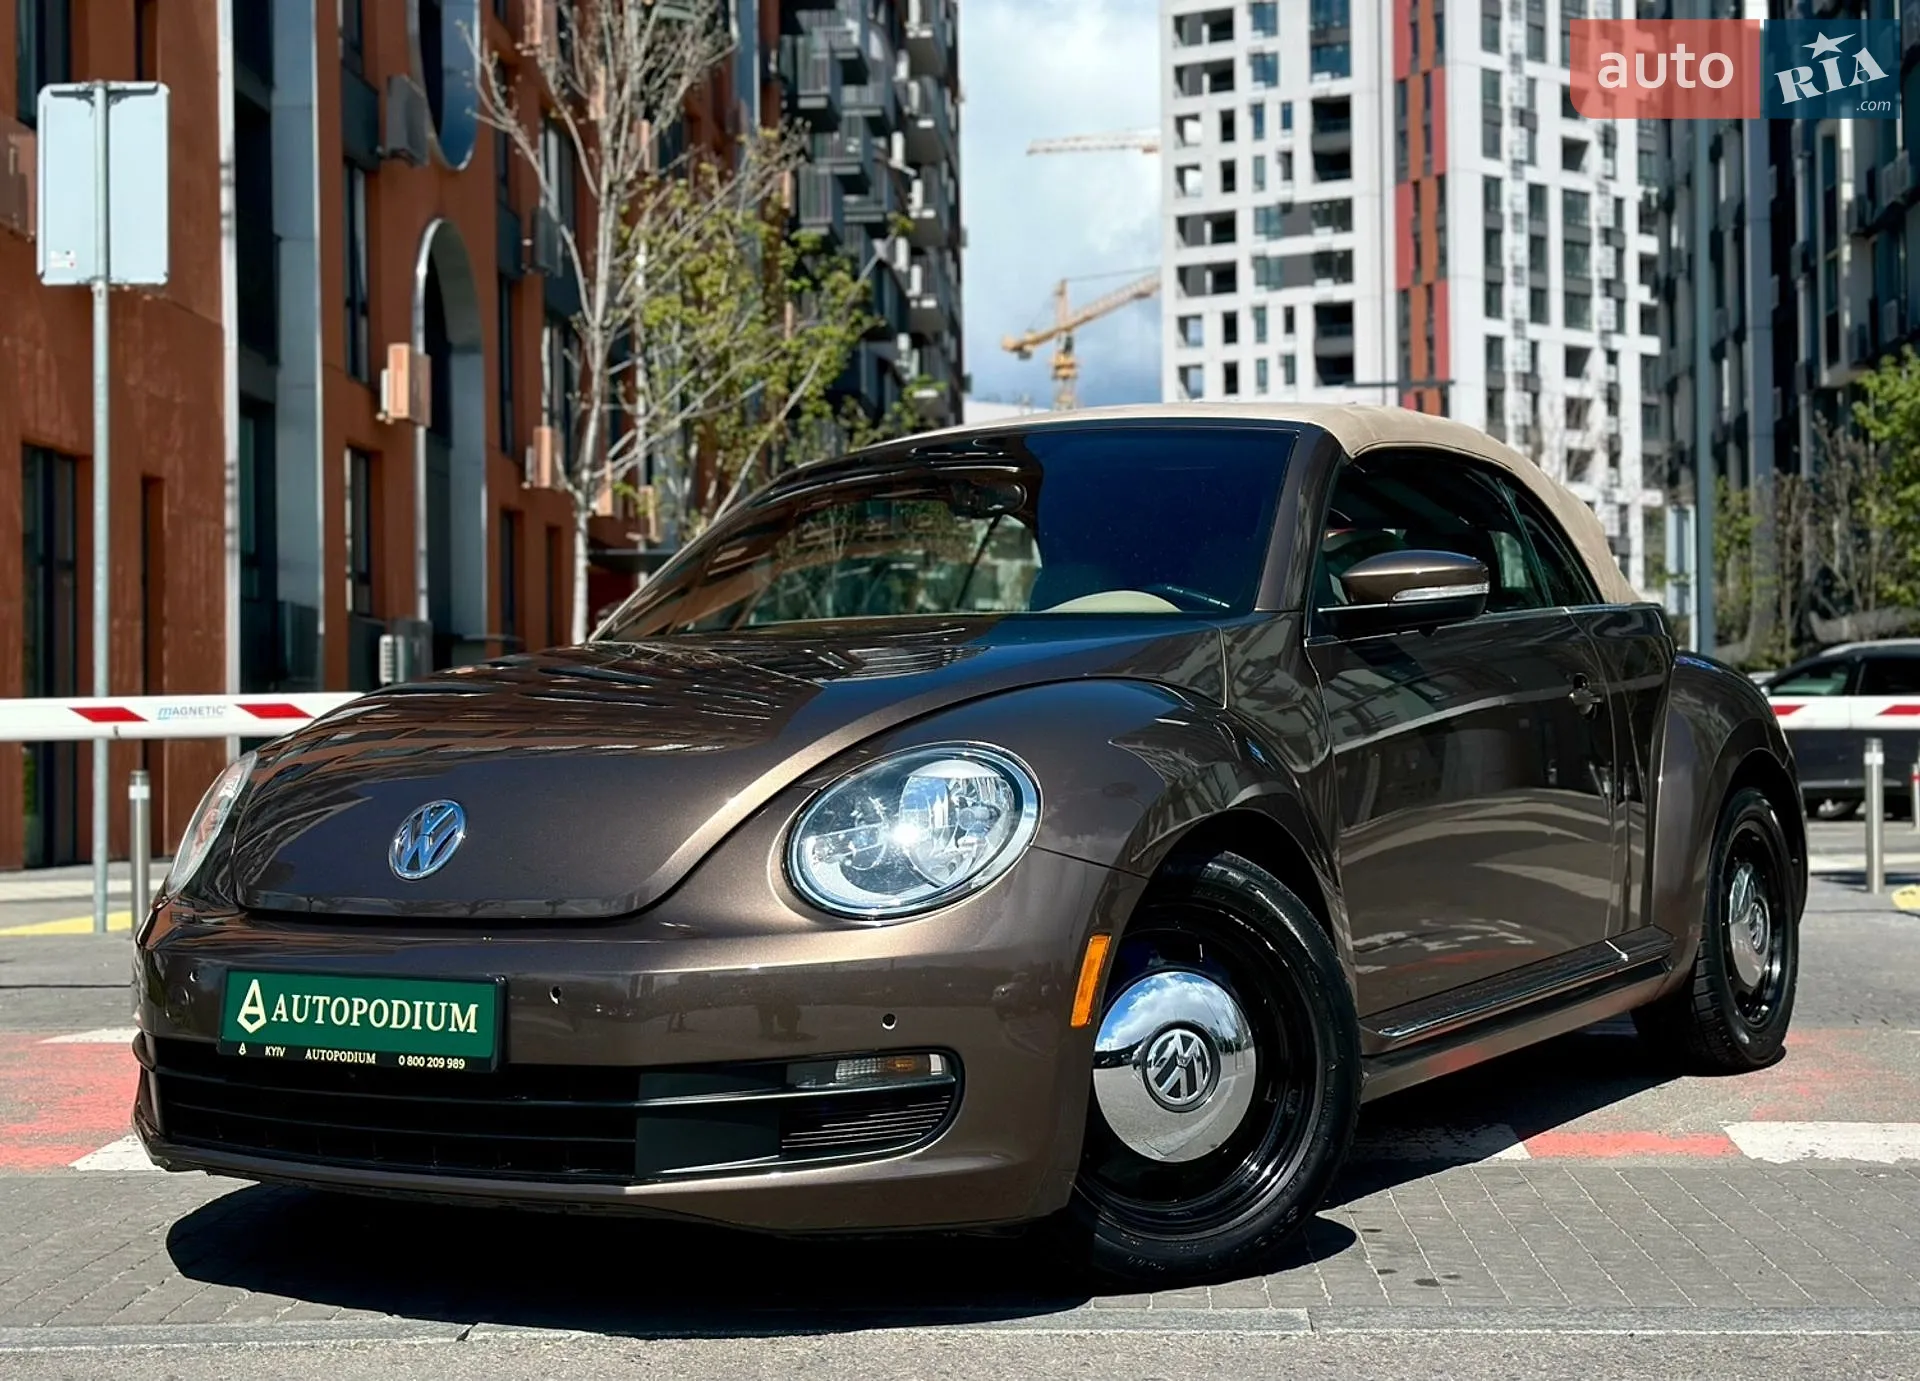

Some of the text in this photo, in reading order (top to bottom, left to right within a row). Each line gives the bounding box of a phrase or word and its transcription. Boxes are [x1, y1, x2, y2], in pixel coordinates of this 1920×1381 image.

[271, 993, 479, 1033] AUTOPODIUM
[264, 1045, 466, 1069] KYIV AUTOPODIUM 0 800 209 989
